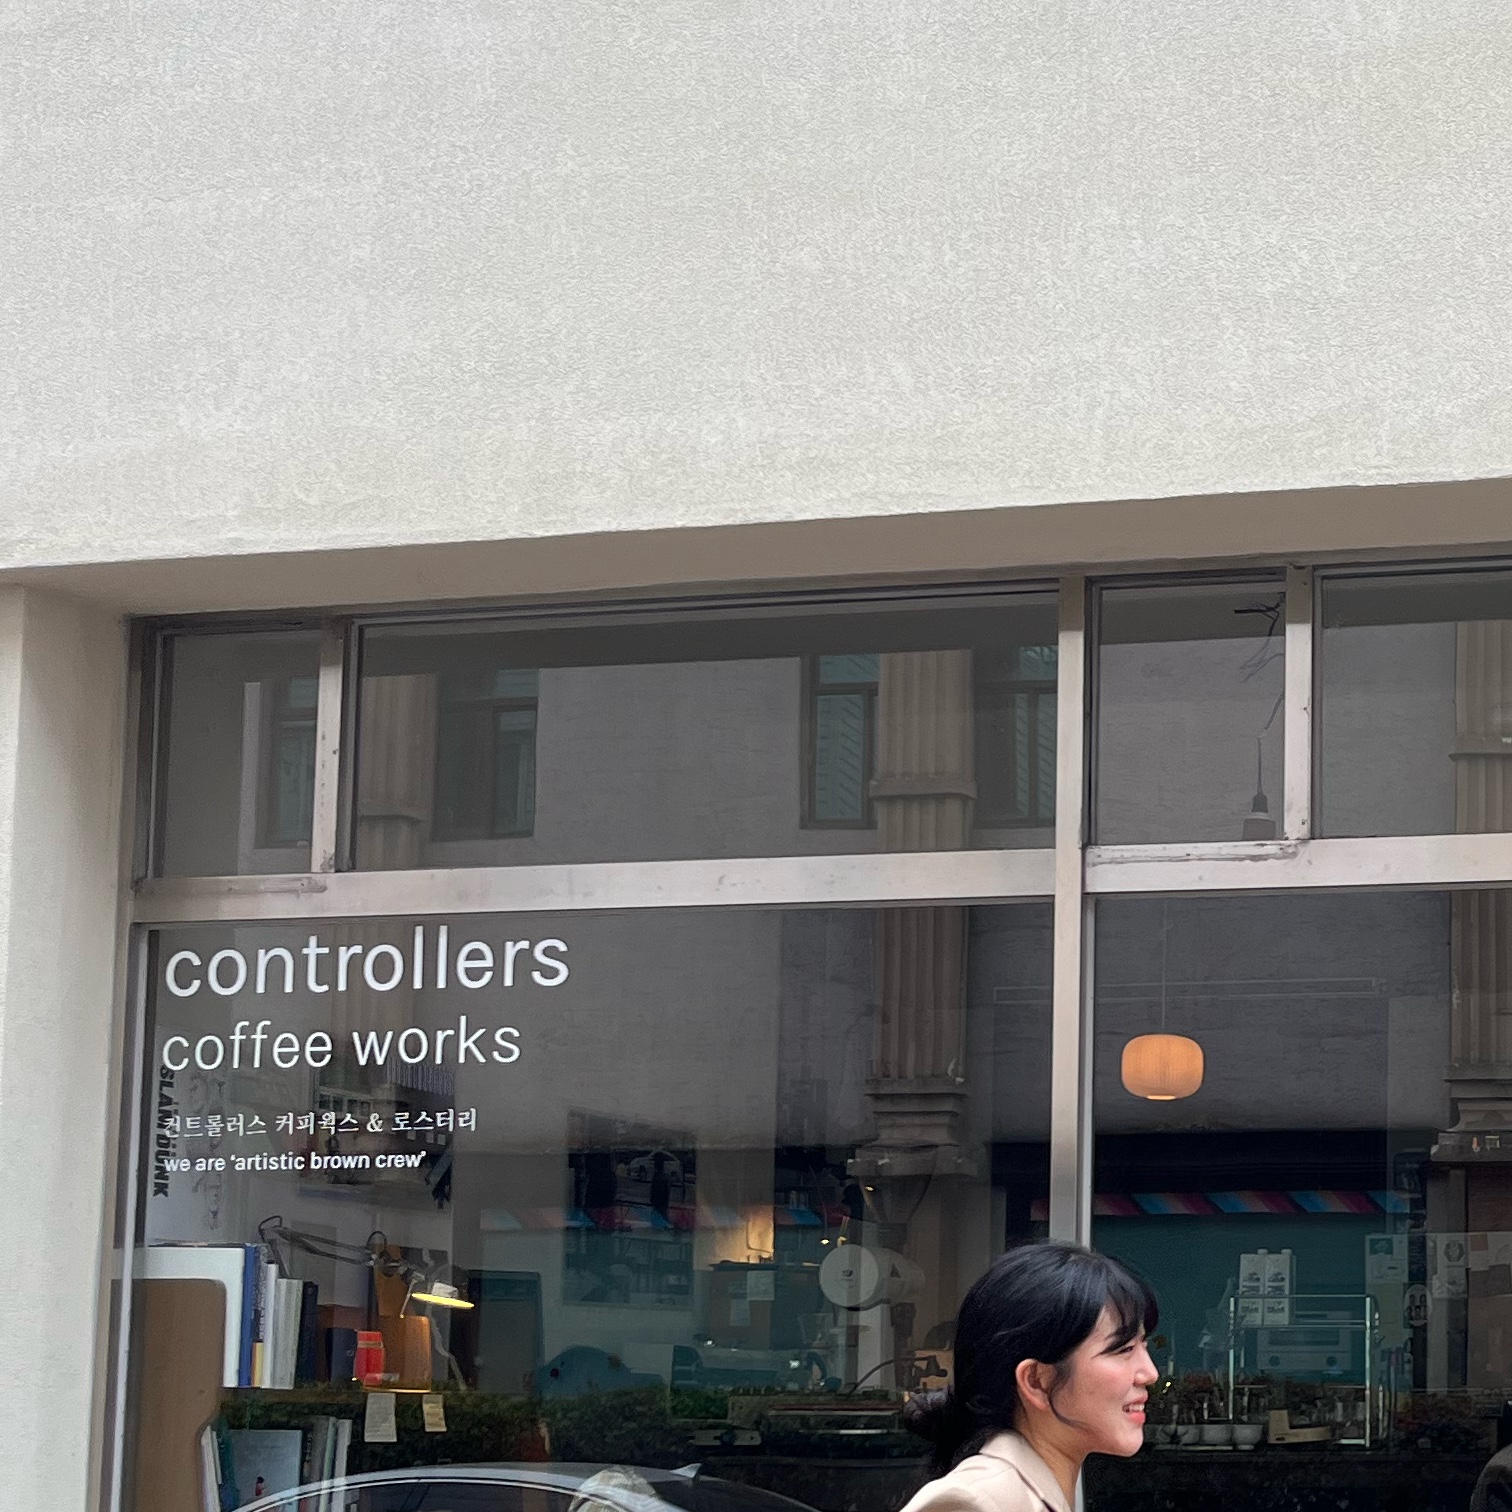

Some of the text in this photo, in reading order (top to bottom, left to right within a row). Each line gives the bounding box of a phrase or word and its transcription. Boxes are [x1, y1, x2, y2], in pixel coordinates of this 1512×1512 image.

[164, 925, 570, 997] controllers
[161, 1014, 522, 1071] coffee works
[163, 1115, 267, 1137] 컨트롤러스
[274, 1112, 360, 1136] 커피웍스
[366, 1115, 383, 1134] &
[392, 1108, 477, 1132] 로스터리
[164, 1156, 191, 1172] we
[195, 1157, 227, 1171] are
[310, 1152, 370, 1169] brown
